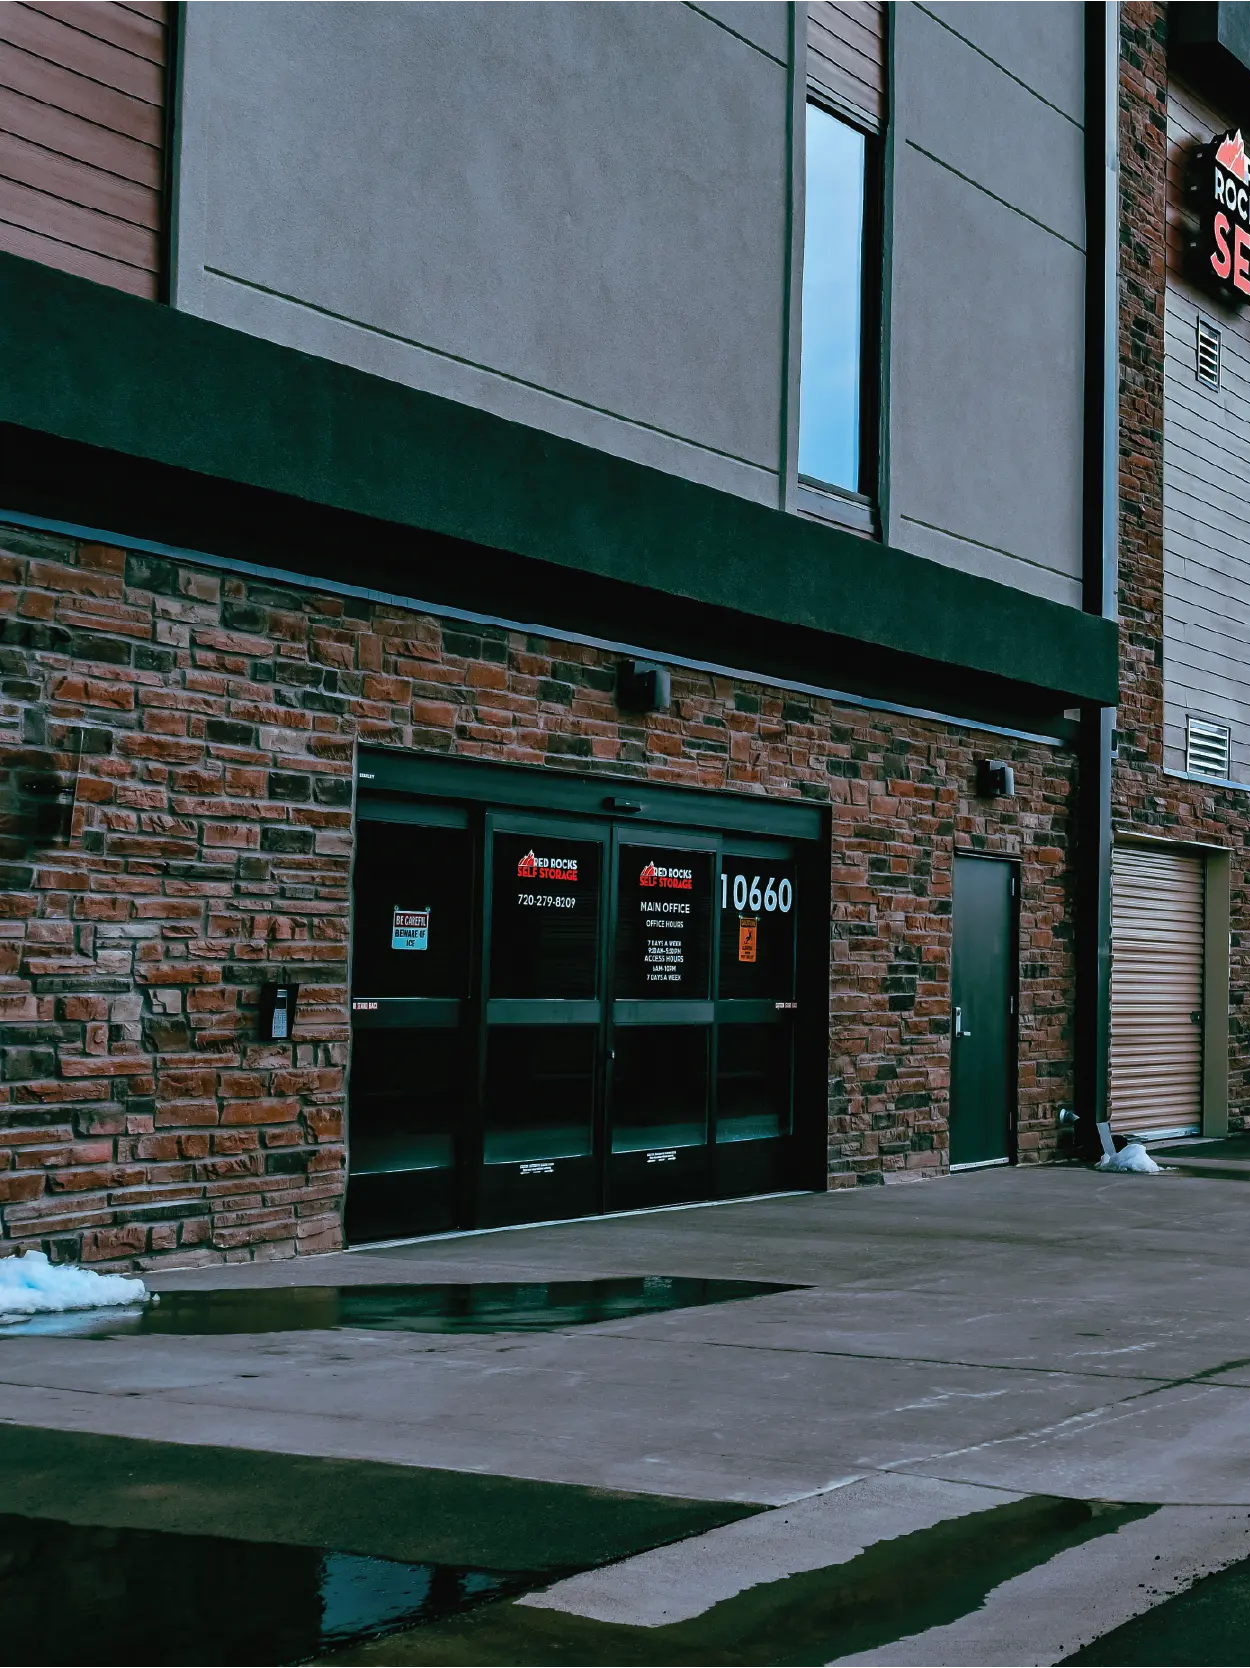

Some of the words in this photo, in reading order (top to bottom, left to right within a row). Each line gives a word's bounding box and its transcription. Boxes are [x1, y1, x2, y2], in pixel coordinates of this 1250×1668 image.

[533, 857, 549, 868] RED
[550, 858, 578, 870] ROCKS
[517, 866, 538, 878] SELF
[539, 867, 579, 881] STORAGE
[653, 866, 667, 877] RED
[668, 868, 692, 879] ROCKS
[639, 876, 658, 887] SELF
[659, 877, 693, 890] STORAGE
[720, 873, 792, 913] 10660
[517, 894, 576, 909] 720-279-8209
[640, 901, 661, 912] MAIN
[662, 902, 690, 914] OFFICE
[395, 915, 404, 926] BE
[646, 919, 665, 928] OFFICE
[665, 920, 684, 929] HOURS
[394, 929, 418, 938] BEWARE
[405, 939, 416, 947] ICE
[644, 955, 665, 963] ACCESS
[665, 955, 684, 963] HOURS
